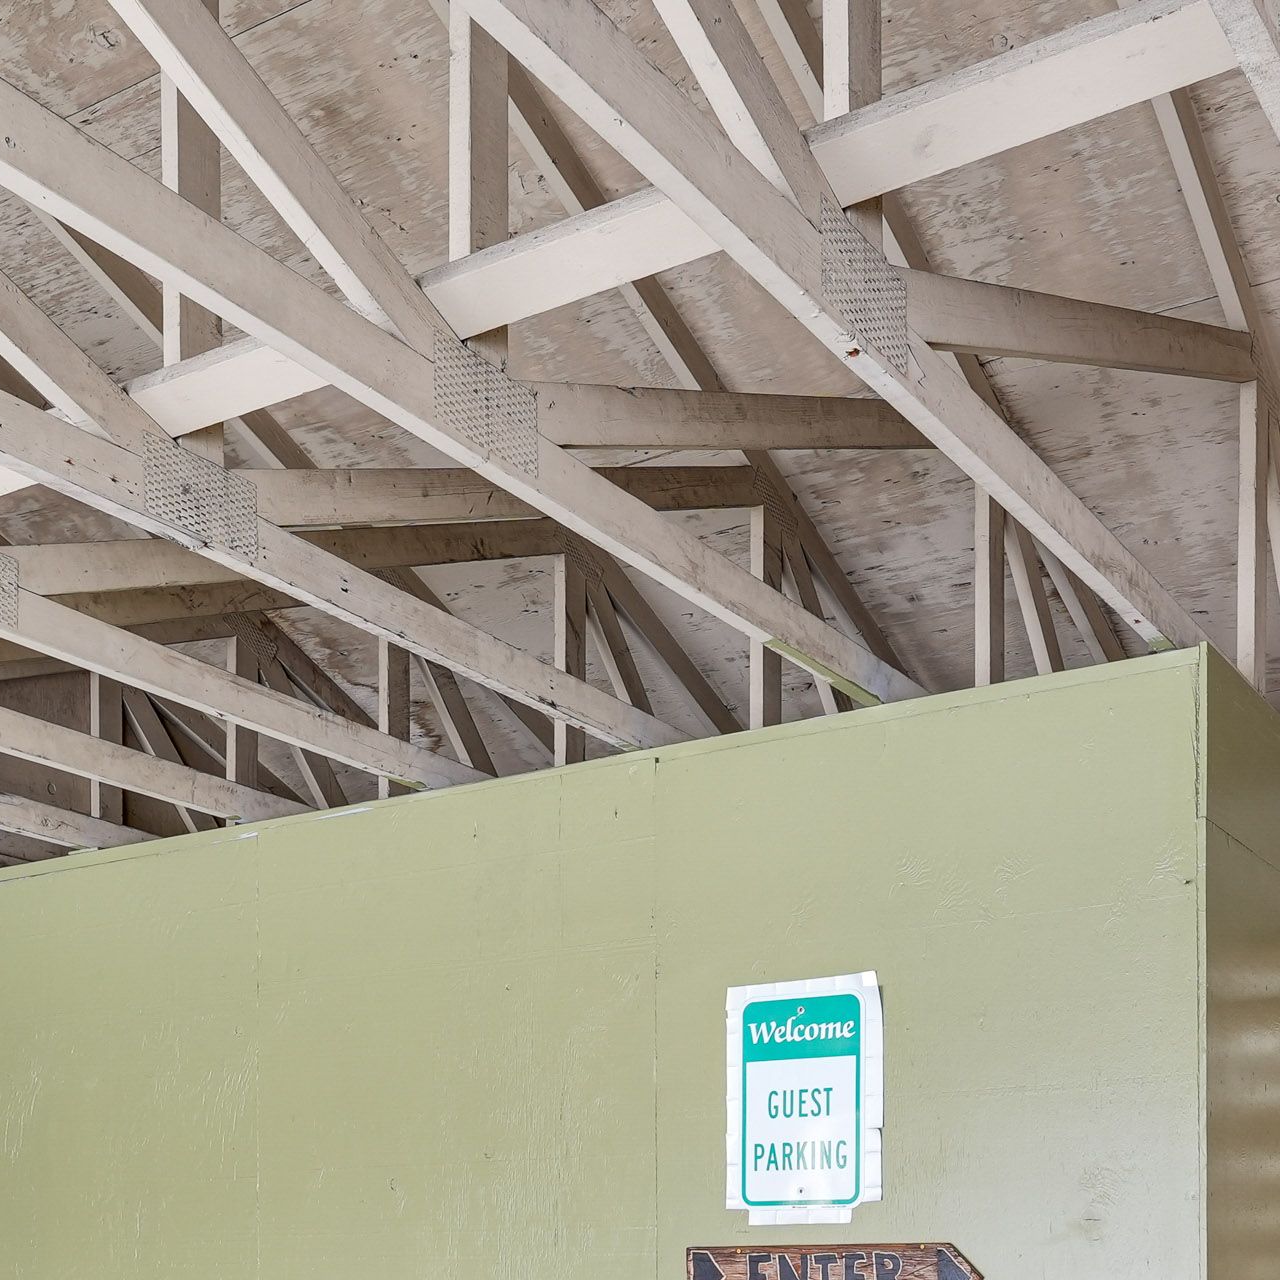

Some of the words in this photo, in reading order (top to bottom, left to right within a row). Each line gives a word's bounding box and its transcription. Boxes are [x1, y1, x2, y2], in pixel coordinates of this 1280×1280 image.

[748, 1014, 856, 1045] Welcome
[767, 1087, 834, 1119] GUEST
[753, 1140, 848, 1172] PARKING
